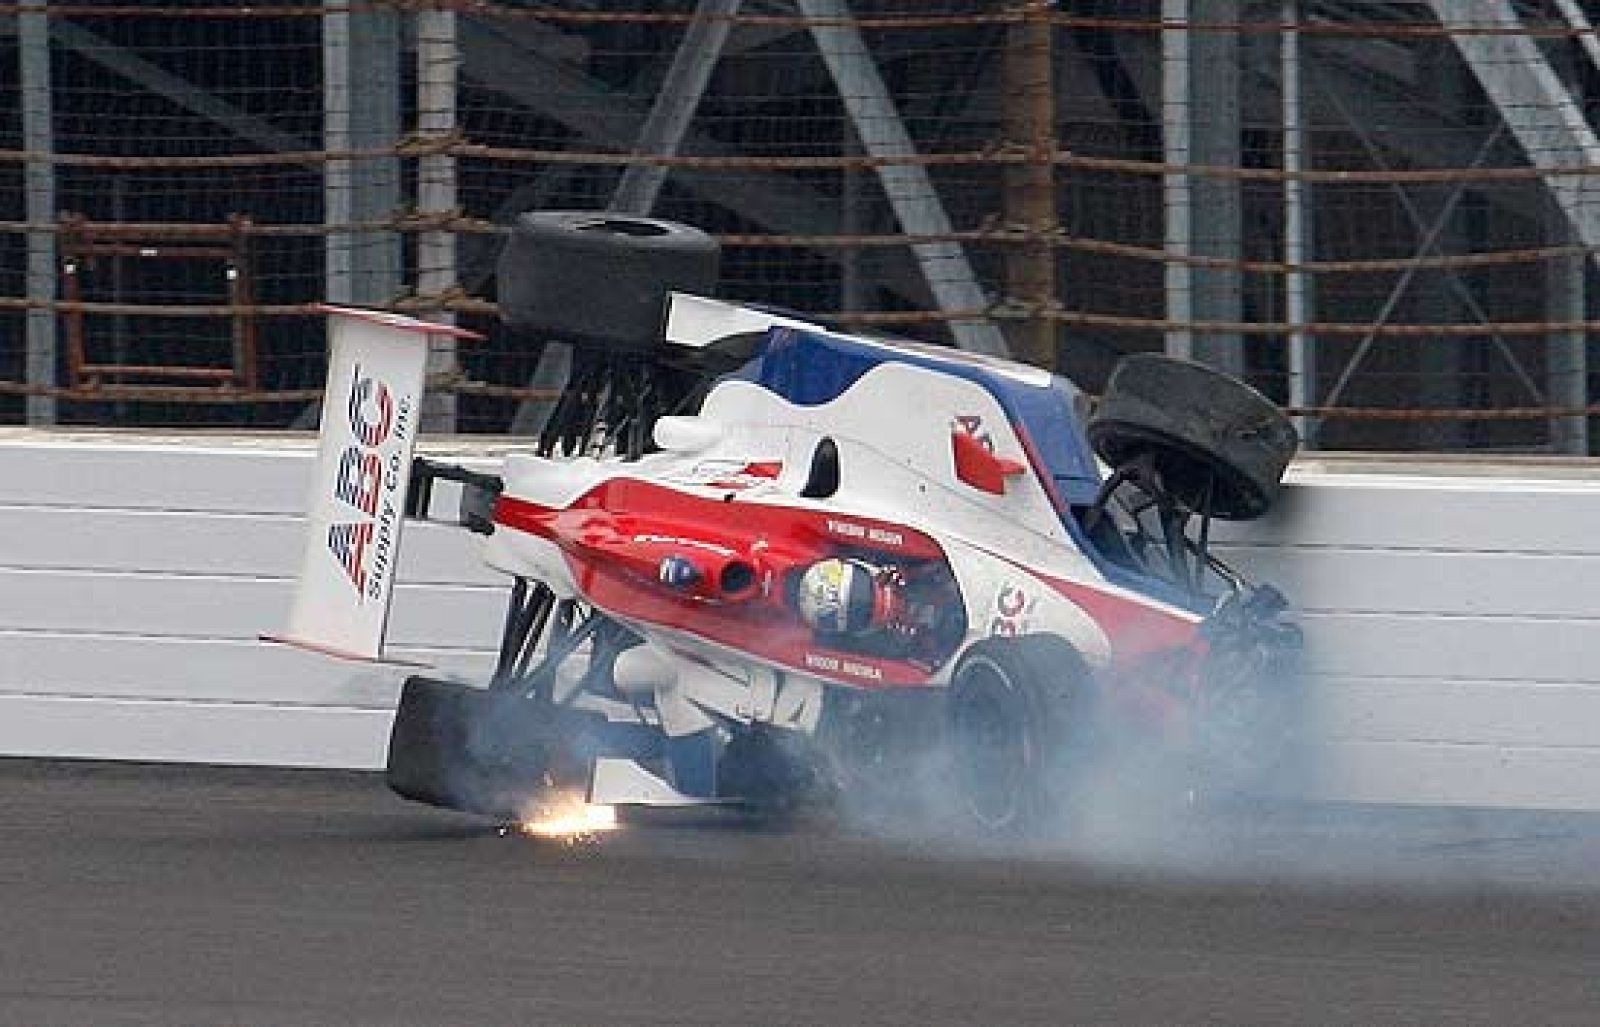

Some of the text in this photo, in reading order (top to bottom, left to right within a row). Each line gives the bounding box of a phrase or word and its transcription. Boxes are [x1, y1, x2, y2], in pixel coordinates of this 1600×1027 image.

[328, 362, 394, 604] ABC
[368, 500, 397, 599] Supply
[385, 450, 402, 493] Co.
